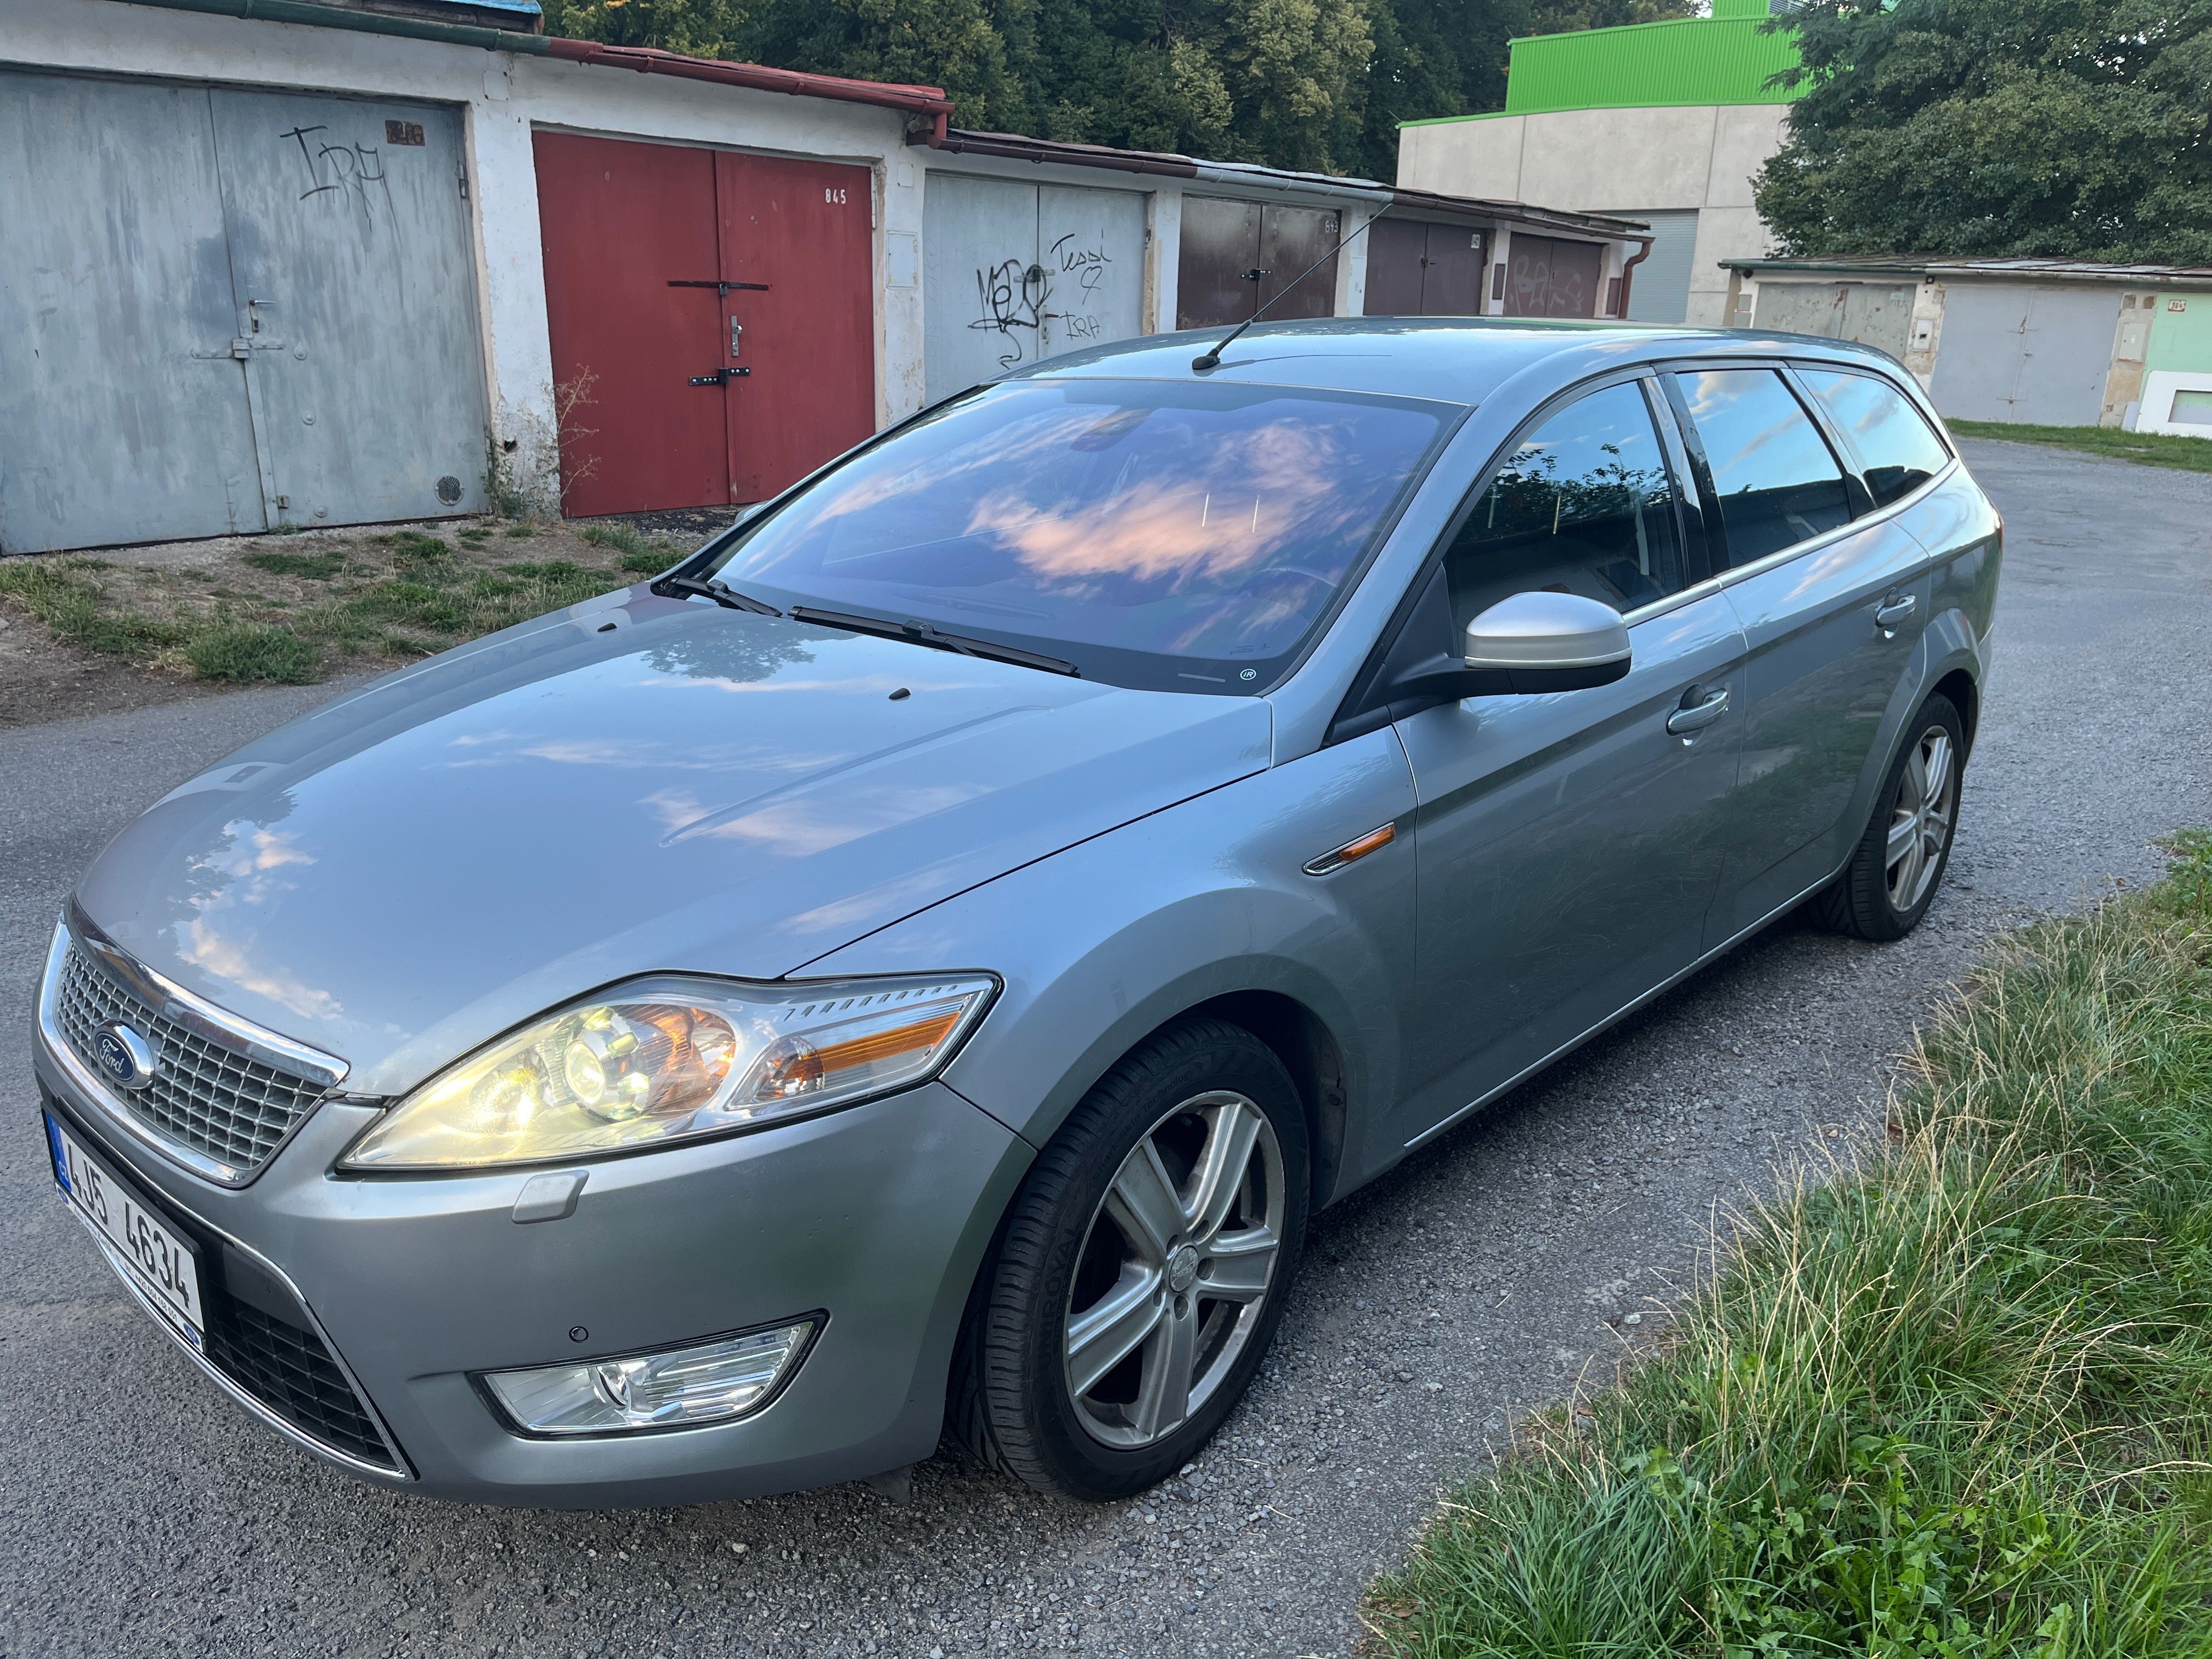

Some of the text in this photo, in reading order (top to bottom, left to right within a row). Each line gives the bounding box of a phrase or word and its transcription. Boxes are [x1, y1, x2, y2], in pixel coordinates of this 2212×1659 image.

[825, 188, 846, 204] 845
[1325, 220, 1339, 233] 843
[1060, 311, 1100, 340] IRA
[99, 1038, 125, 1074] Ford
[59, 1160, 69, 1182] CZ
[68, 1143, 190, 1310] 4J5 4634
[1037, 1221, 1081, 1371] UNIROYAL
